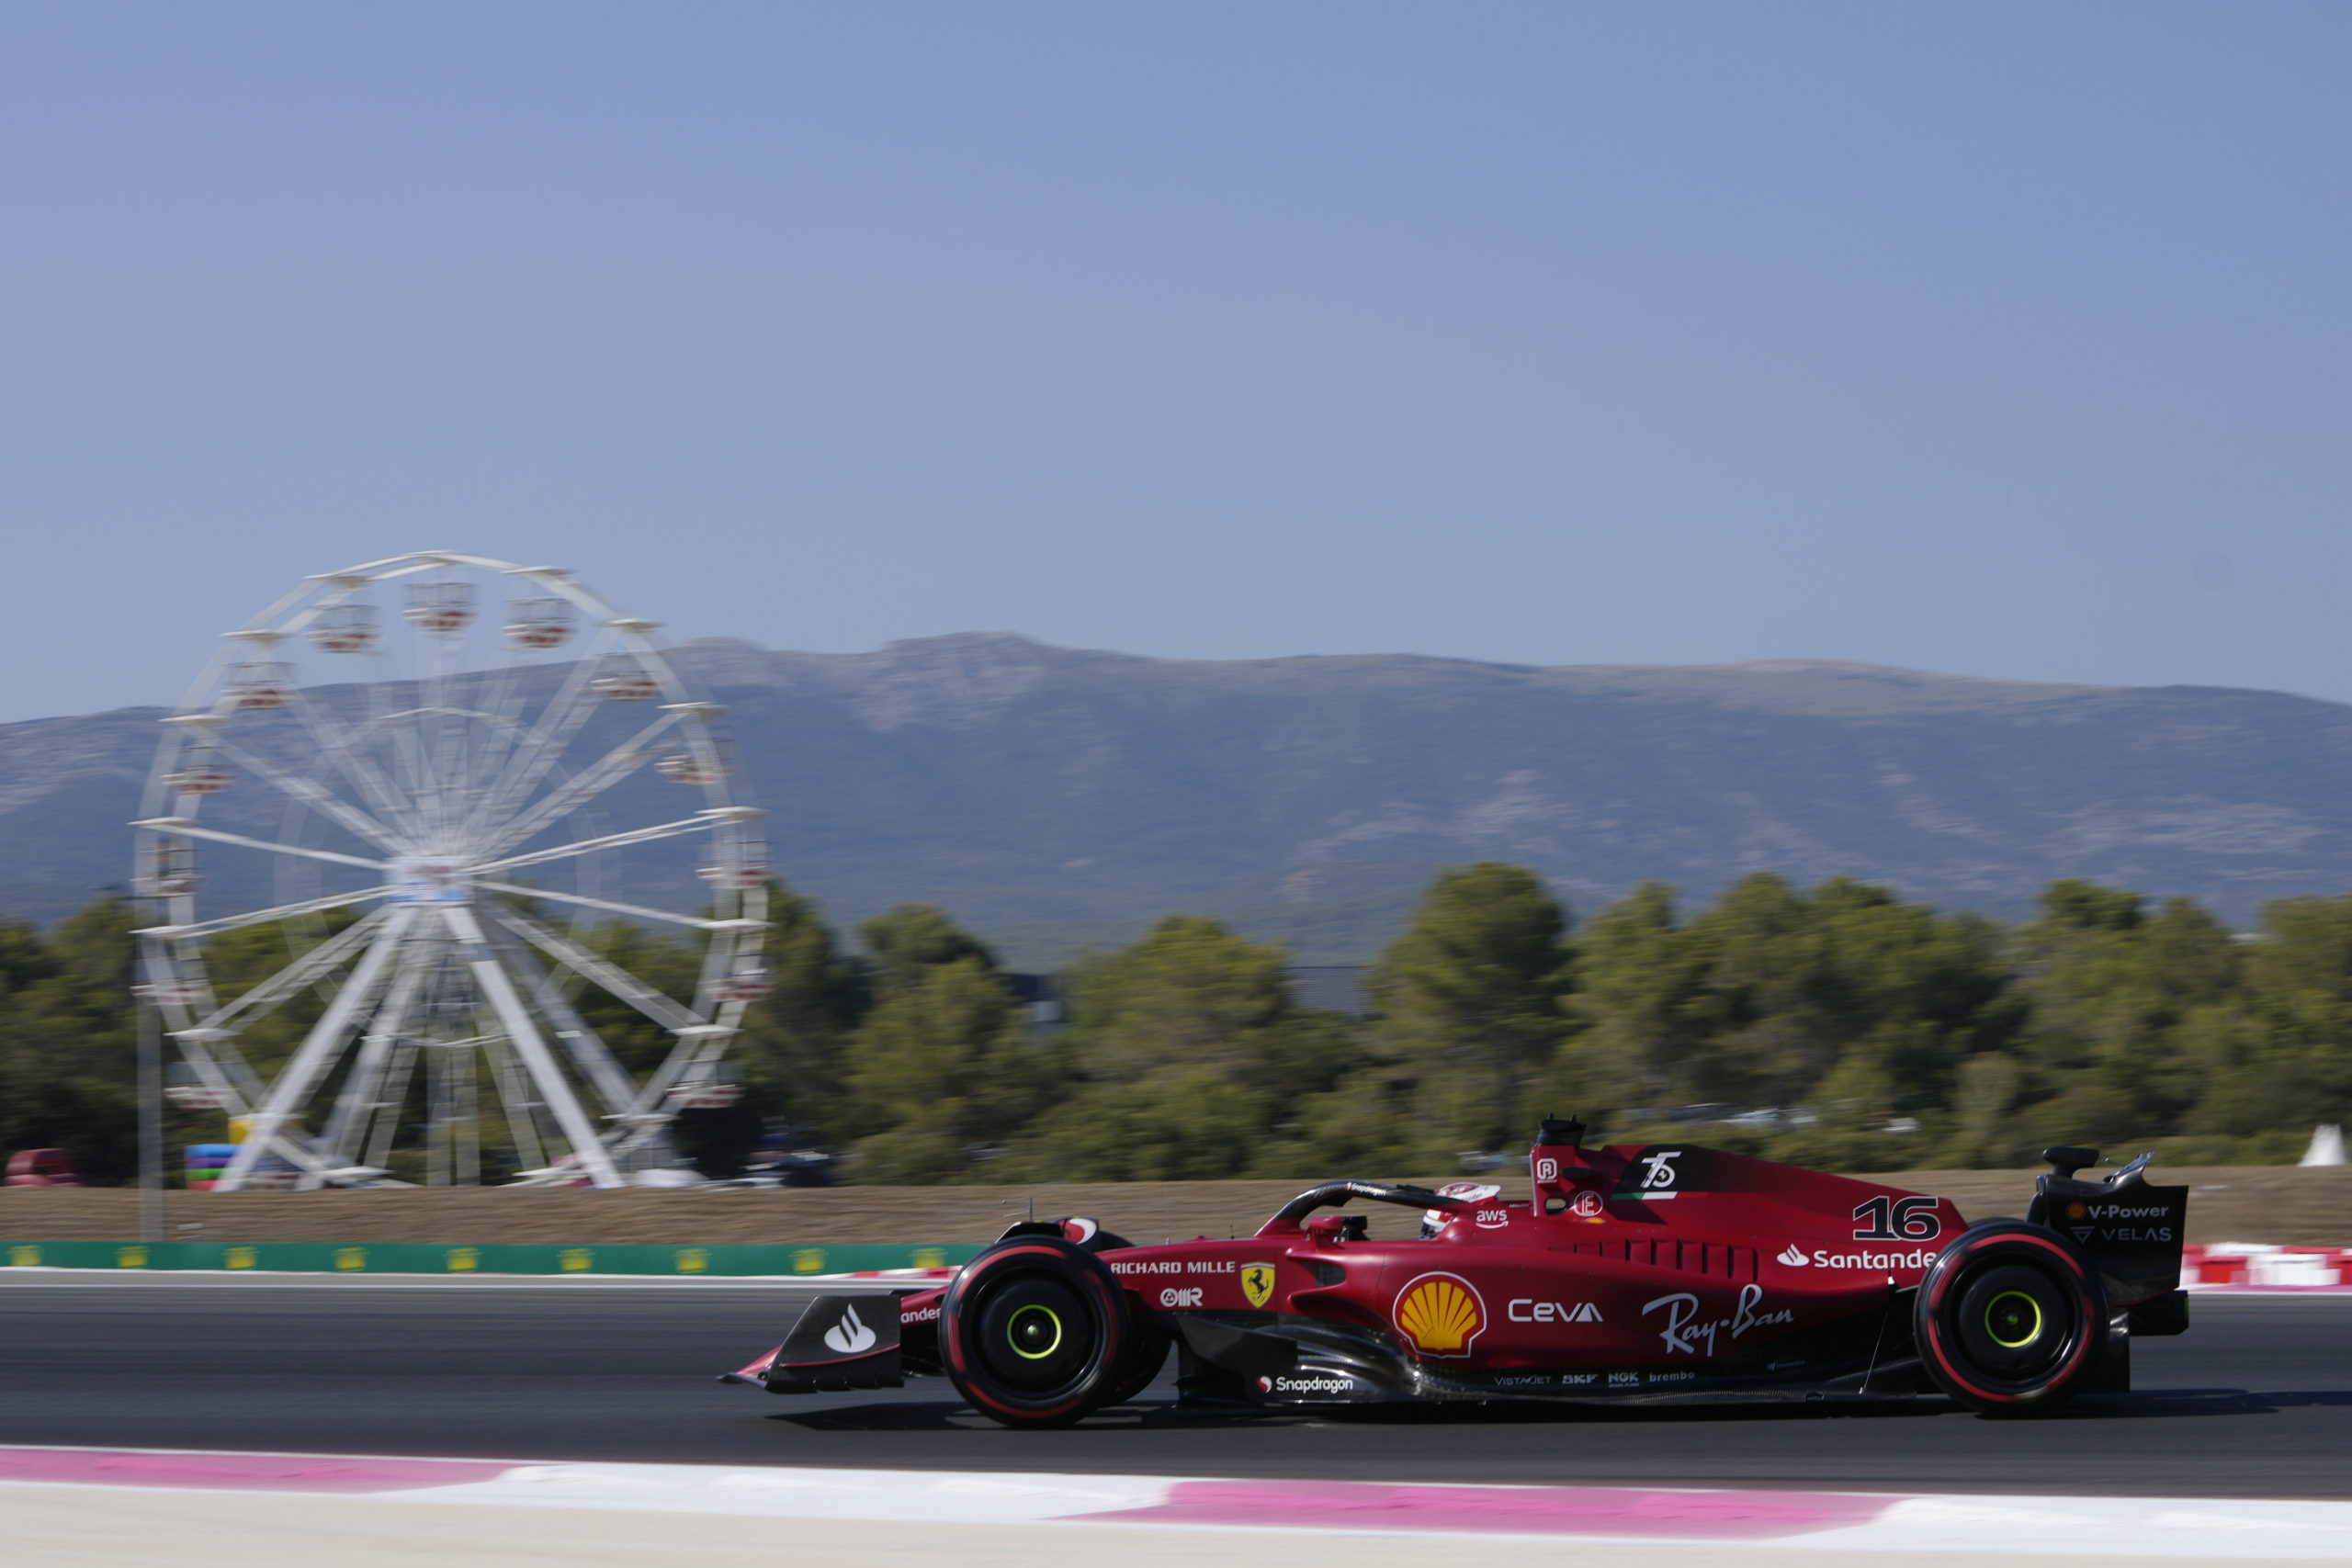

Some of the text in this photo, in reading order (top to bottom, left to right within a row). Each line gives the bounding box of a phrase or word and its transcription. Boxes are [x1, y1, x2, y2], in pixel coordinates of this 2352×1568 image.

[1476, 1209, 1508, 1222] aws
[1852, 1195, 1940, 1242] 16
[2087, 1204, 2169, 1219] V-Power
[2101, 1227, 2172, 1242] VELAS
[1813, 1248, 1938, 1269] Santande
[1110, 1261, 1236, 1274] RICHARD MILLE
[900, 1306, 942, 1324] ander
[1276, 1375, 1353, 1393] Snapdragon
[1562, 1374, 1599, 1384] SKF
[1608, 1371, 1639, 1382] NGK
[1648, 1371, 1695, 1382] brembo
